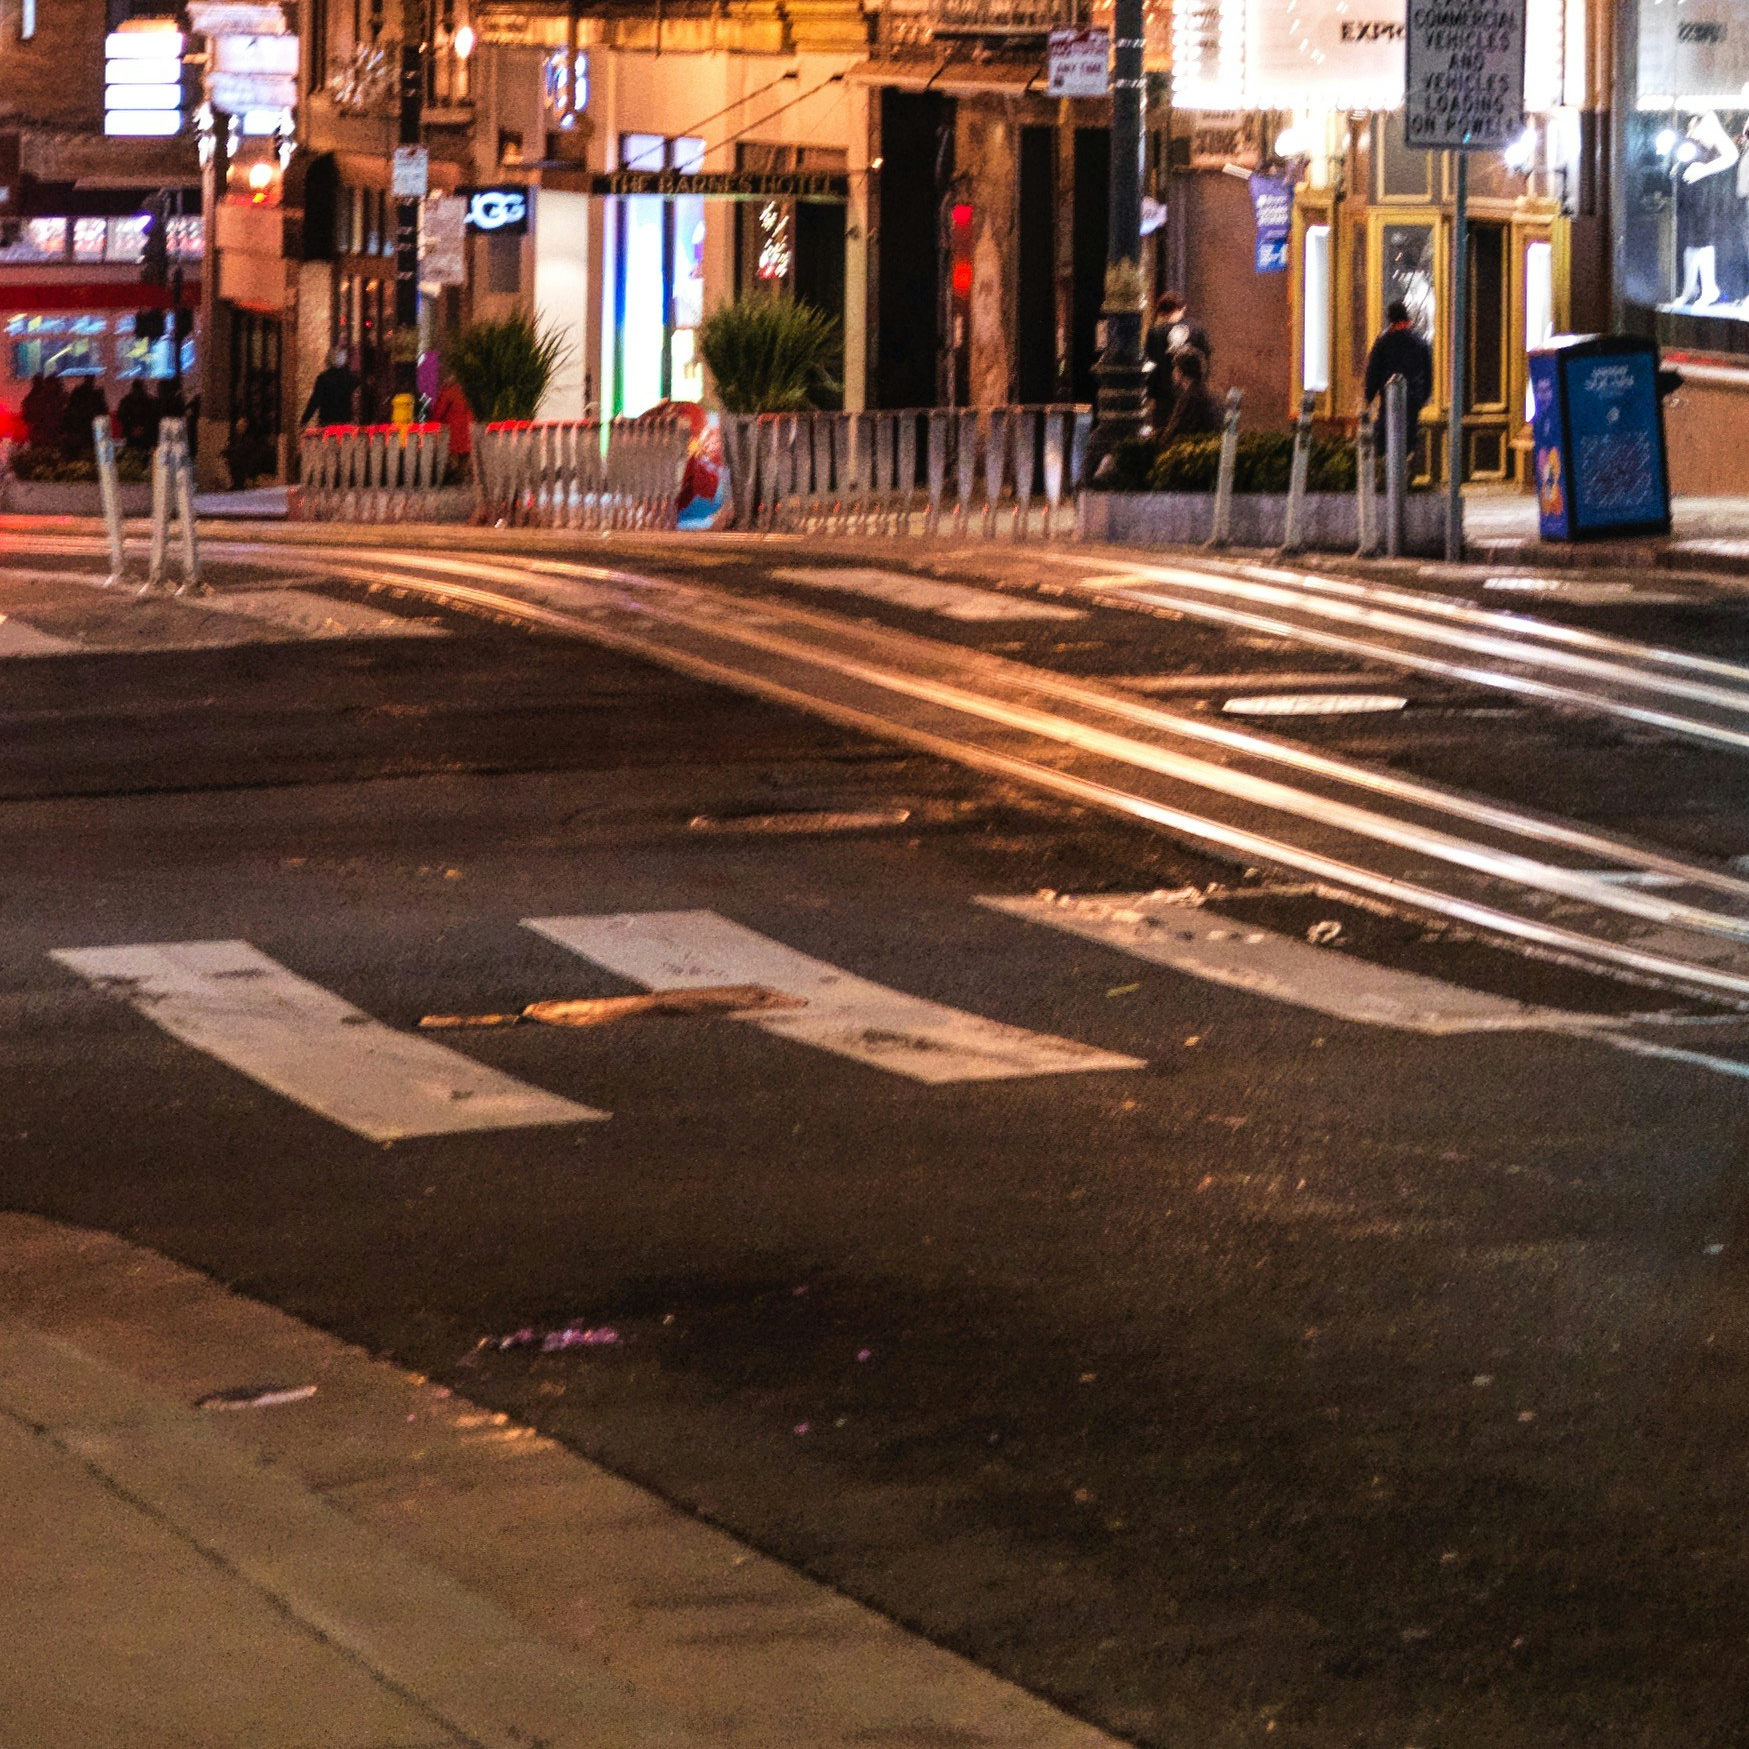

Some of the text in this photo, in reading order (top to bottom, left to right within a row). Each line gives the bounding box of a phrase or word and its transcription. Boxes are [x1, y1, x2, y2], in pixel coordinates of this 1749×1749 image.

[1414, 8, 1518, 30] COMMERCIAL
[1426, 29, 1511, 51] VEHICLES
[1448, 52, 1485, 72] AND
[1424, 71, 1511, 93] VEHICLES
[1424, 95, 1505, 115] LOADING
[1411, 116, 1436, 134] ON
[610, 173, 648, 194] THE
